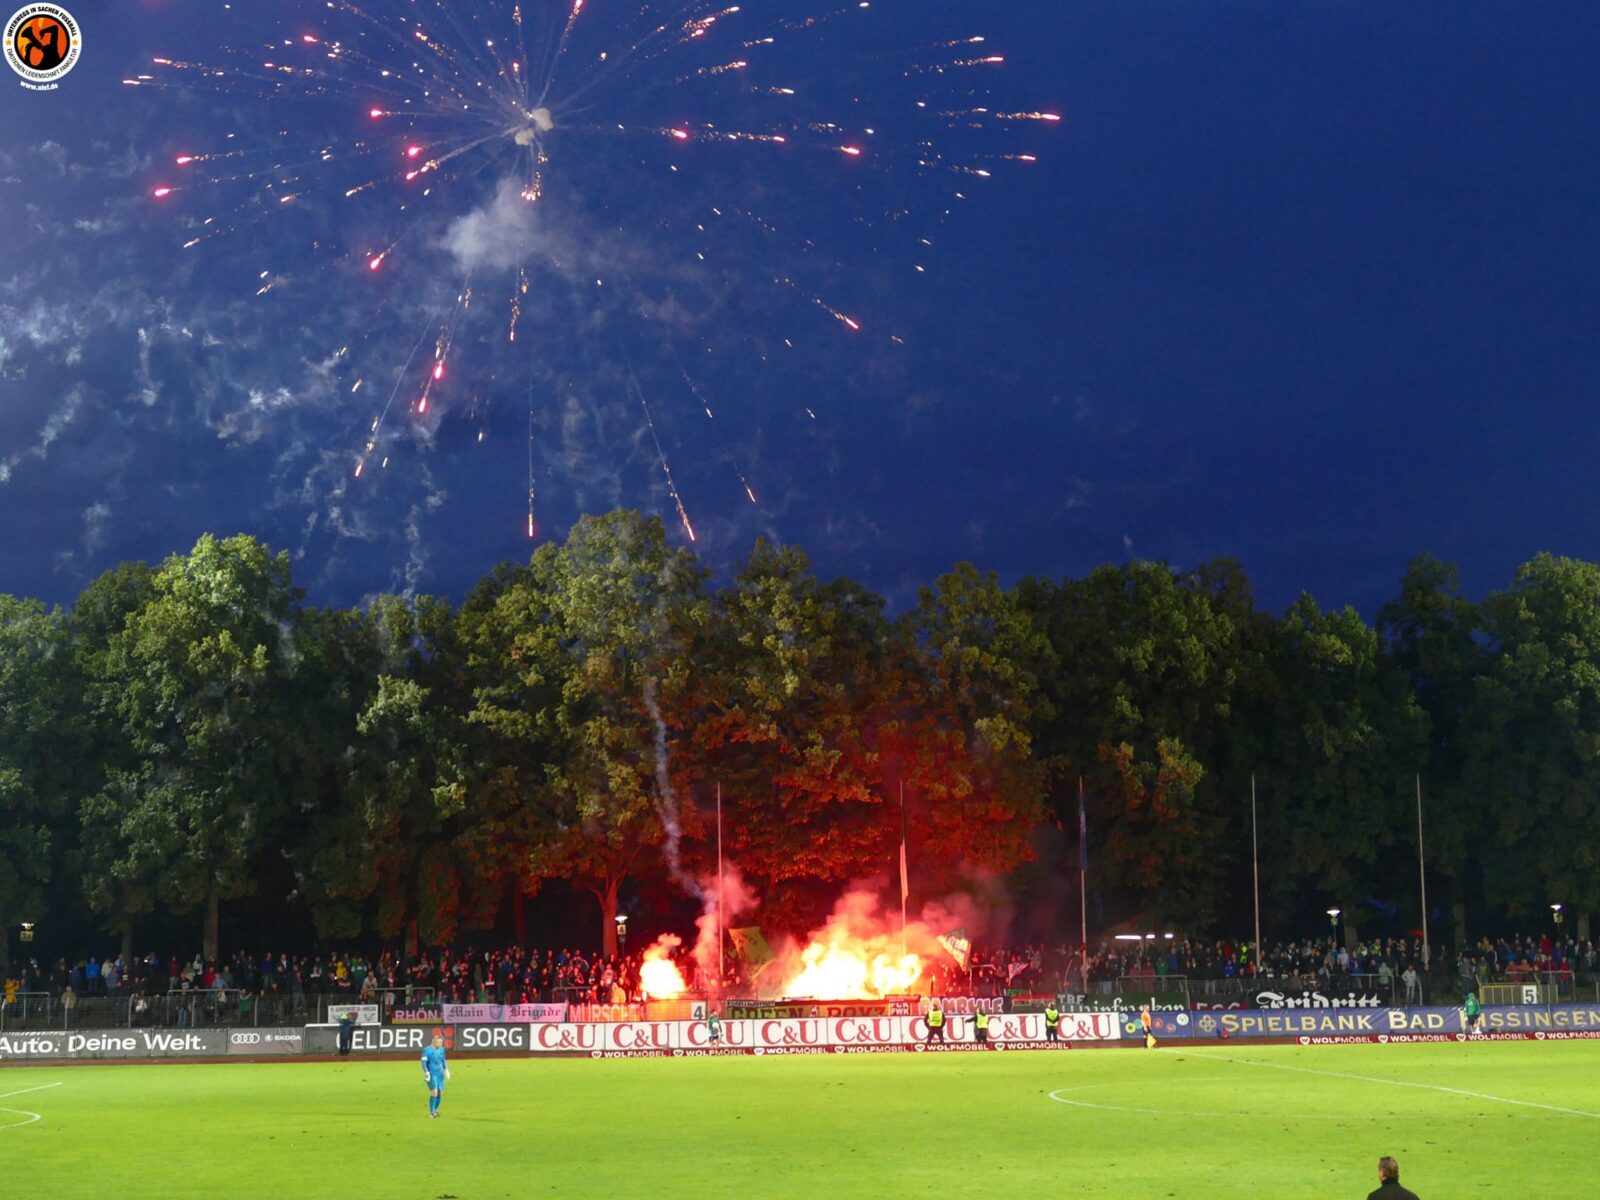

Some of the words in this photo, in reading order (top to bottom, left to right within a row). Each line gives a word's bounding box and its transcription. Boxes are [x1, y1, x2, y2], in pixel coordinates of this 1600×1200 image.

[1525, 989, 1534, 1003] 5
[395, 1007, 438, 1020] RHÖN
[448, 1005, 483, 1018] Main
[508, 1004, 561, 1019] Brigade
[693, 1005, 703, 1019] 4
[909, 1017, 965, 1042] CU
[1057, 1013, 1112, 1039] C&U
[1221, 1013, 1374, 1033] SPIELBANK
[1388, 1011, 1444, 1030] BAD
[538, 1023, 596, 1049] C&U
[613, 1023, 671, 1049] C&U
[687, 1021, 745, 1046] CU
[761, 1020, 818, 1046] C&U
[835, 1018, 892, 1043] C&U
[1390, 1034, 1451, 1042] WOLFMÖBEL
[1467, 1033, 1529, 1041] WOLFMÖBEL
[1547, 1031, 1600, 1039] WOLFMÖBE
[68, 1034, 136, 1052] Deine
[143, 1033, 206, 1050] Welt.
[336, 1028, 424, 1050] ELDER
[462, 1027, 523, 1047] SORG
[1312, 1036, 1373, 1044] WOLFMÖBEL
[604, 1050, 665, 1058] WOLFMÖBEL
[686, 1049, 747, 1057] WOLFMÖBEL
[927, 1043, 989, 1051] WOLFMÖBEL
